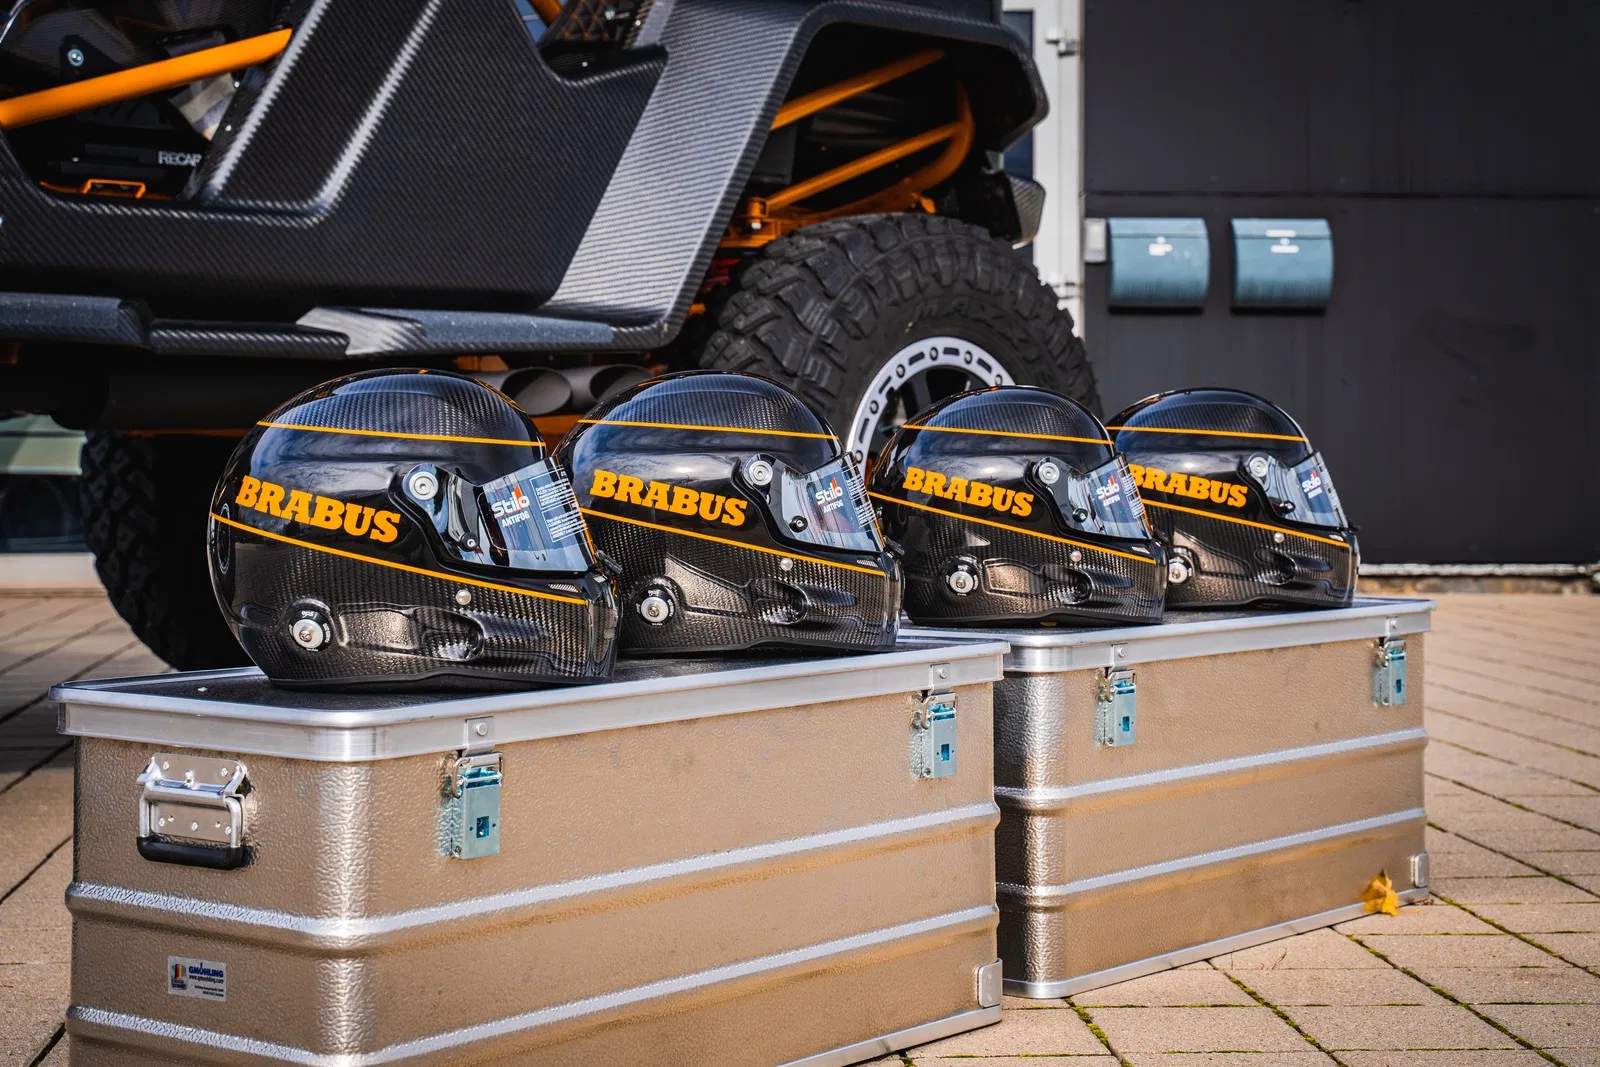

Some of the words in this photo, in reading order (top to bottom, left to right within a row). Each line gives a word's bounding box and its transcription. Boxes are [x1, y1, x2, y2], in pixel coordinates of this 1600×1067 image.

[491, 484, 531, 518] Stilo
[590, 469, 748, 527] BRABUS
[815, 477, 843, 505] Stilo
[902, 466, 1035, 517] BRABUS
[1128, 463, 1248, 508] BRABUS
[235, 475, 401, 543] BRABUS
[501, 511, 530, 528] ANTIFOG
